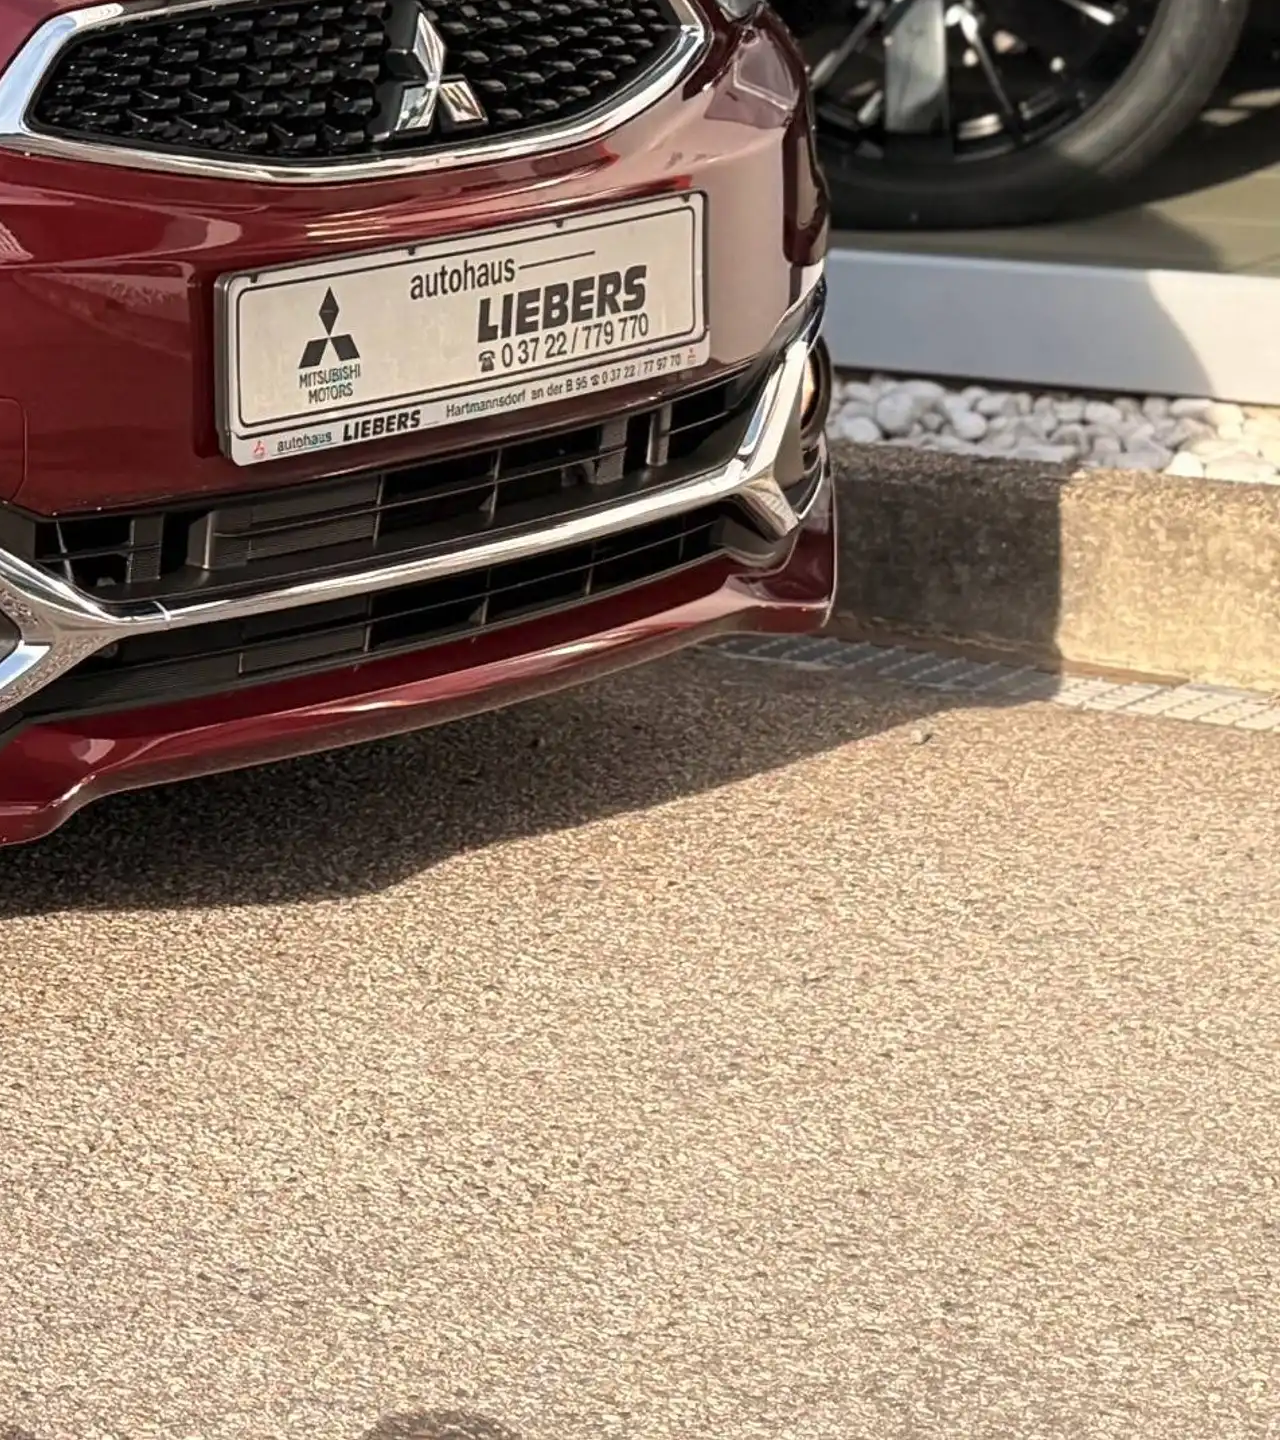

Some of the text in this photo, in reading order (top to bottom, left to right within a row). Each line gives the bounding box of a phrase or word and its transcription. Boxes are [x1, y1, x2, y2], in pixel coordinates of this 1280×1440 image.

[410, 258, 516, 300] autohaus
[477, 264, 648, 343] LIEBERS
[501, 343, 514, 368] 0
[518, 336, 541, 364] 37
[545, 330, 568, 359] 22
[582, 319, 614, 350] 779
[620, 313, 650, 341] 770
[299, 364, 361, 389] MITSUBISHI
[308, 382, 354, 404] MOTORS
[277, 431, 332, 453] autohaus
[343, 410, 421, 442] LIEBERS
[445, 389, 527, 418] Hartmannsdorf
[531, 388, 544, 401] an
[547, 382, 563, 397] der
[565, 379, 573, 393] B
